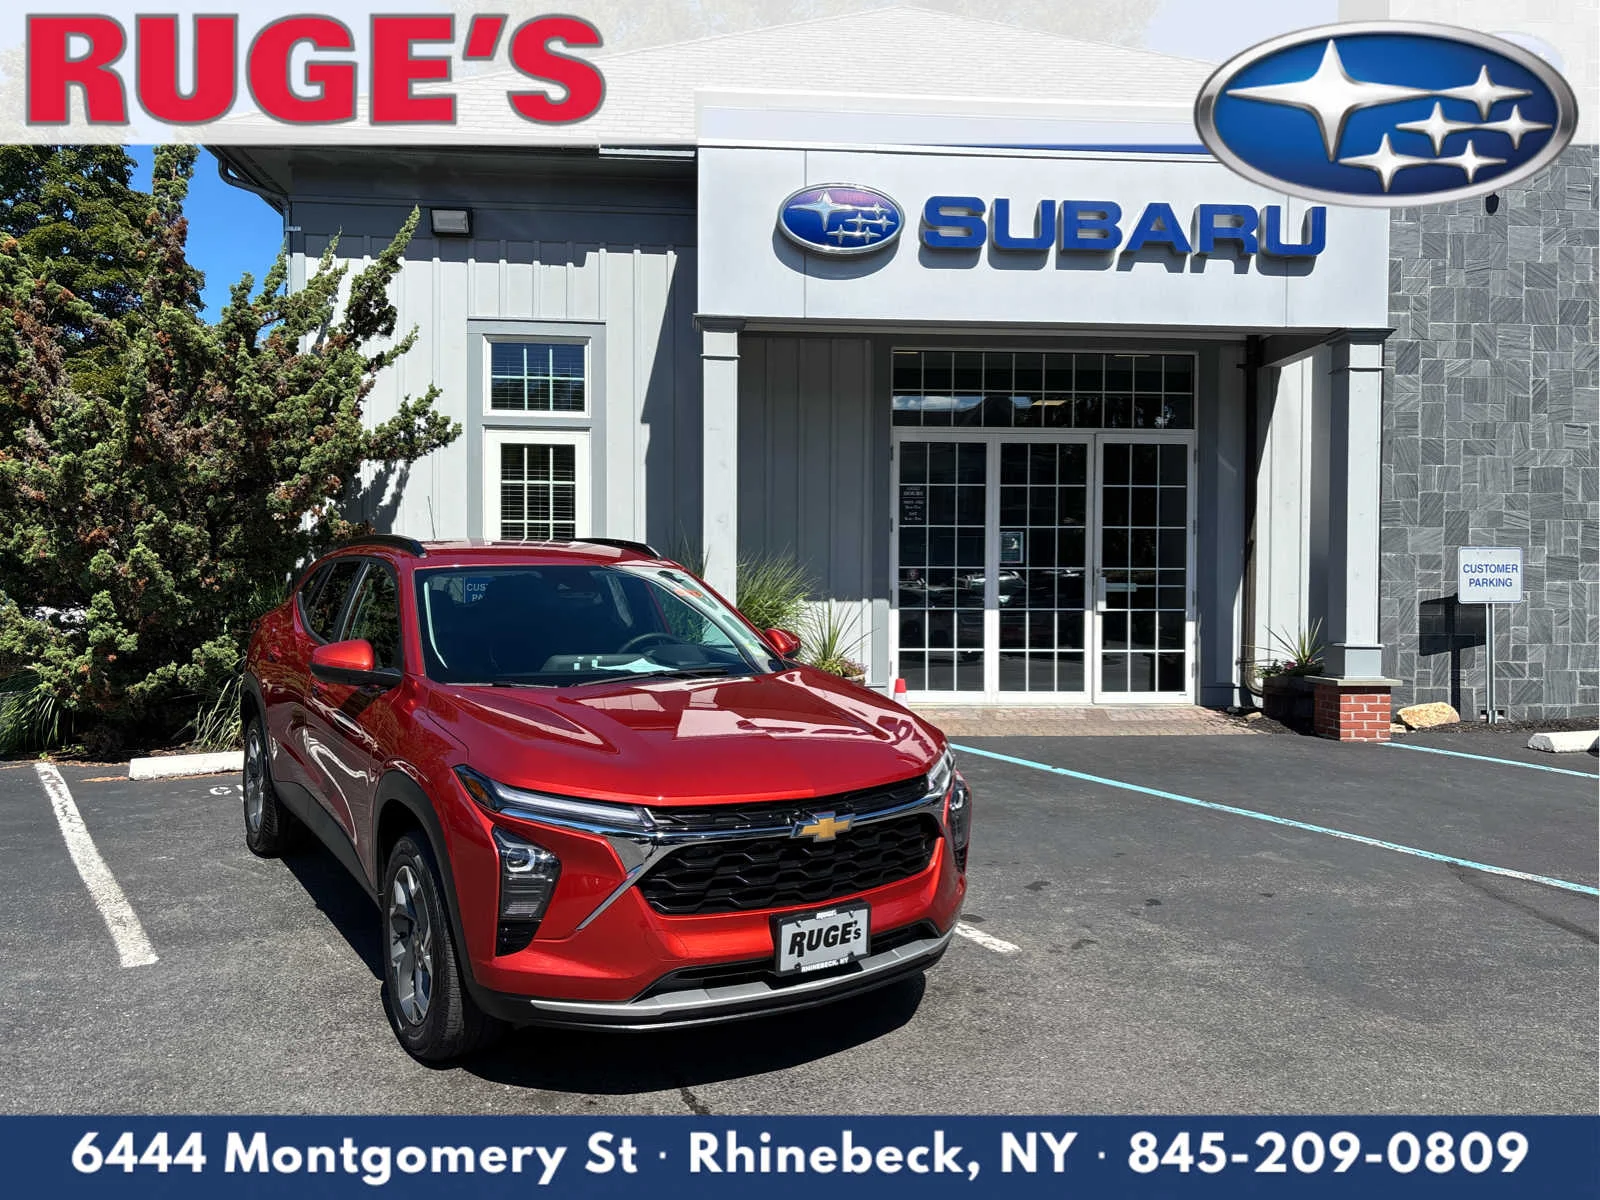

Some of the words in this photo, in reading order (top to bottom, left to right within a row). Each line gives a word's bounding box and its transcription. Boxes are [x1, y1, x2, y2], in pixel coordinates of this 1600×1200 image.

[919, 196, 1327, 257] SUBARU
[1463, 563, 1519, 574] CUSTOMER
[1469, 578, 1513, 587] PARKING
